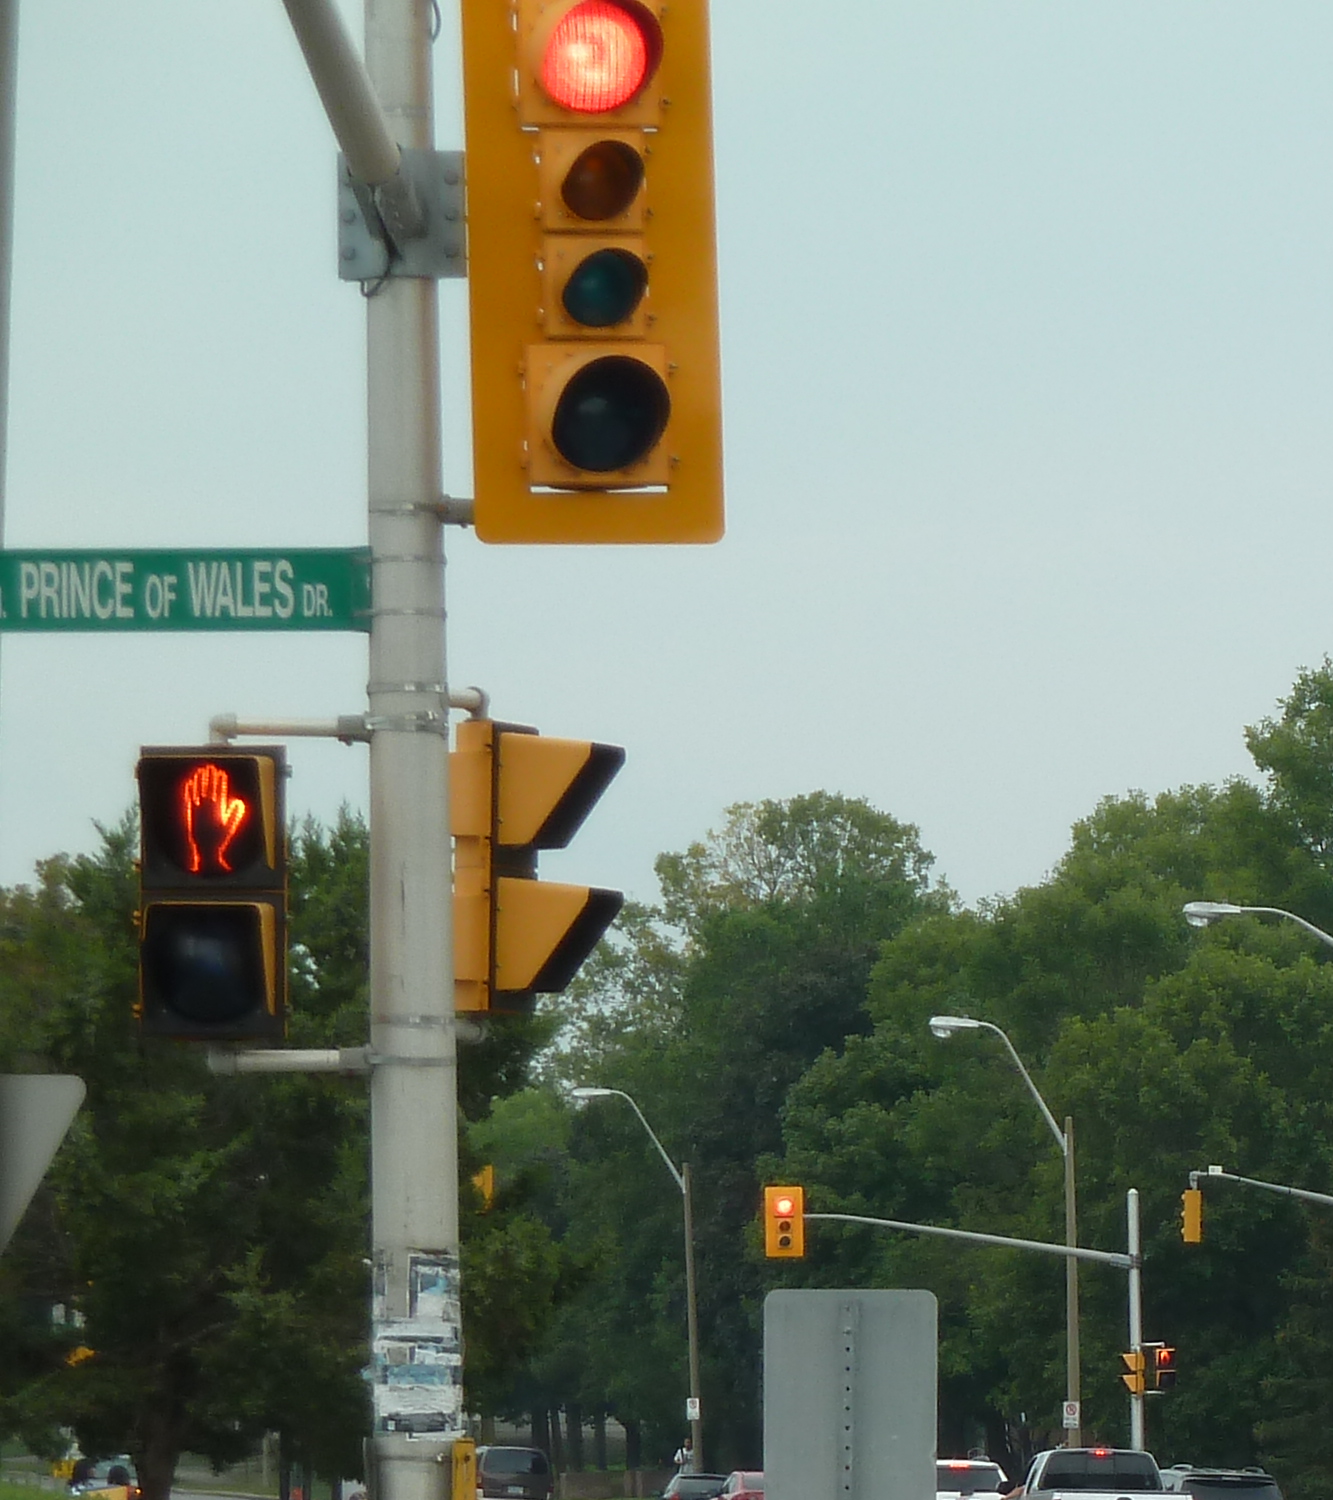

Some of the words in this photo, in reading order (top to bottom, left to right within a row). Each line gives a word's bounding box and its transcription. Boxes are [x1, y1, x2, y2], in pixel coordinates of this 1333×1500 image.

[20, 560, 135, 619] PRINCE
[145, 574, 177, 618] OF
[188, 559, 295, 619] WALES
[304, 584, 333, 618] DR.
